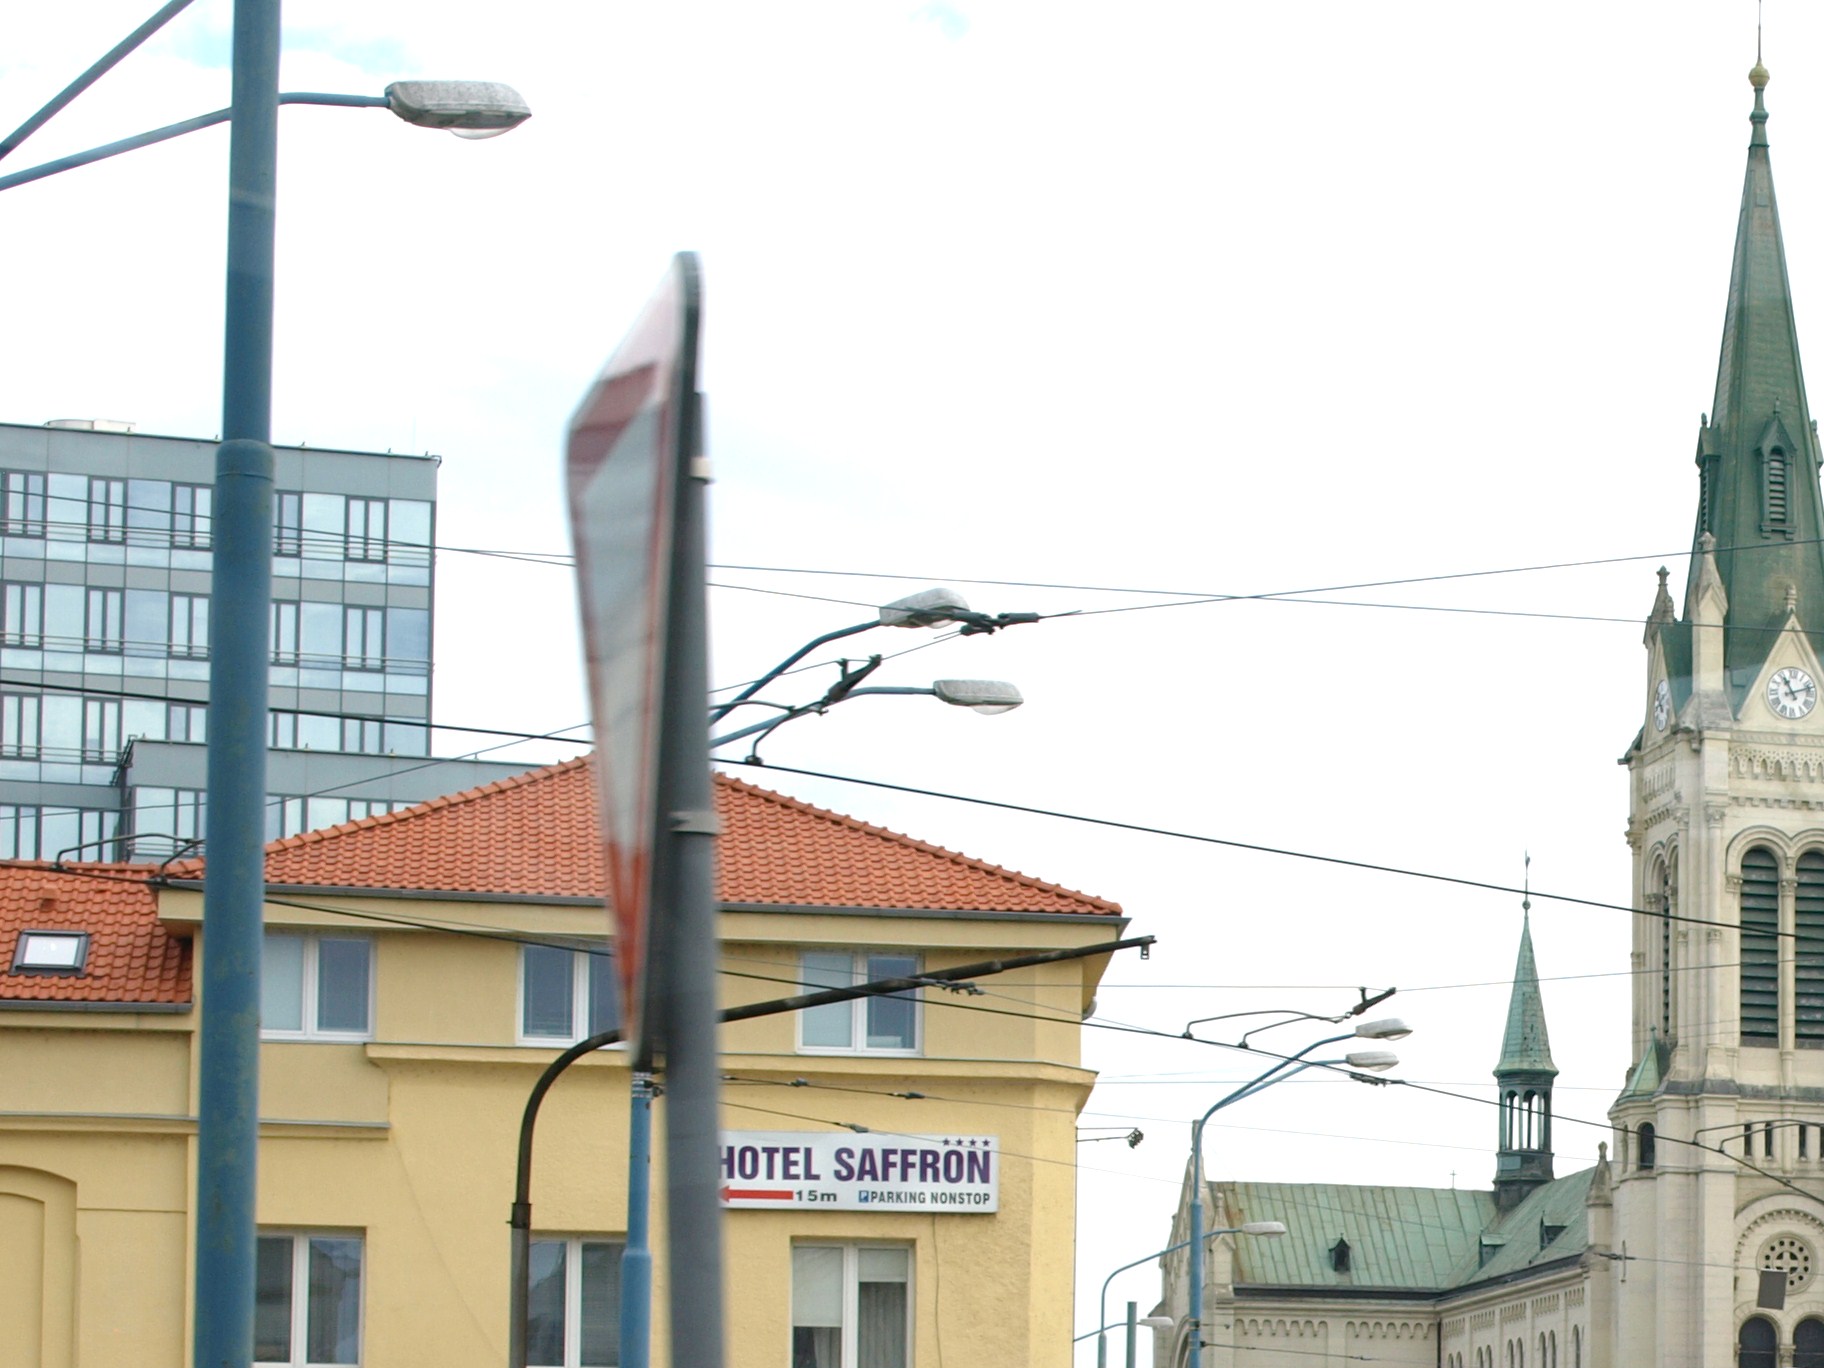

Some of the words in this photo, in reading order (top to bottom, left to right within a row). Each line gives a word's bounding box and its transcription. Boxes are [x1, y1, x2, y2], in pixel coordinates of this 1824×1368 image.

[719, 1145, 821, 1181] HOTEL
[833, 1147, 991, 1184] SAFFRON
[796, 1189, 838, 1202] 15m
[870, 1191, 926, 1205] PARKING
[930, 1192, 991, 1205] NONSTOP
